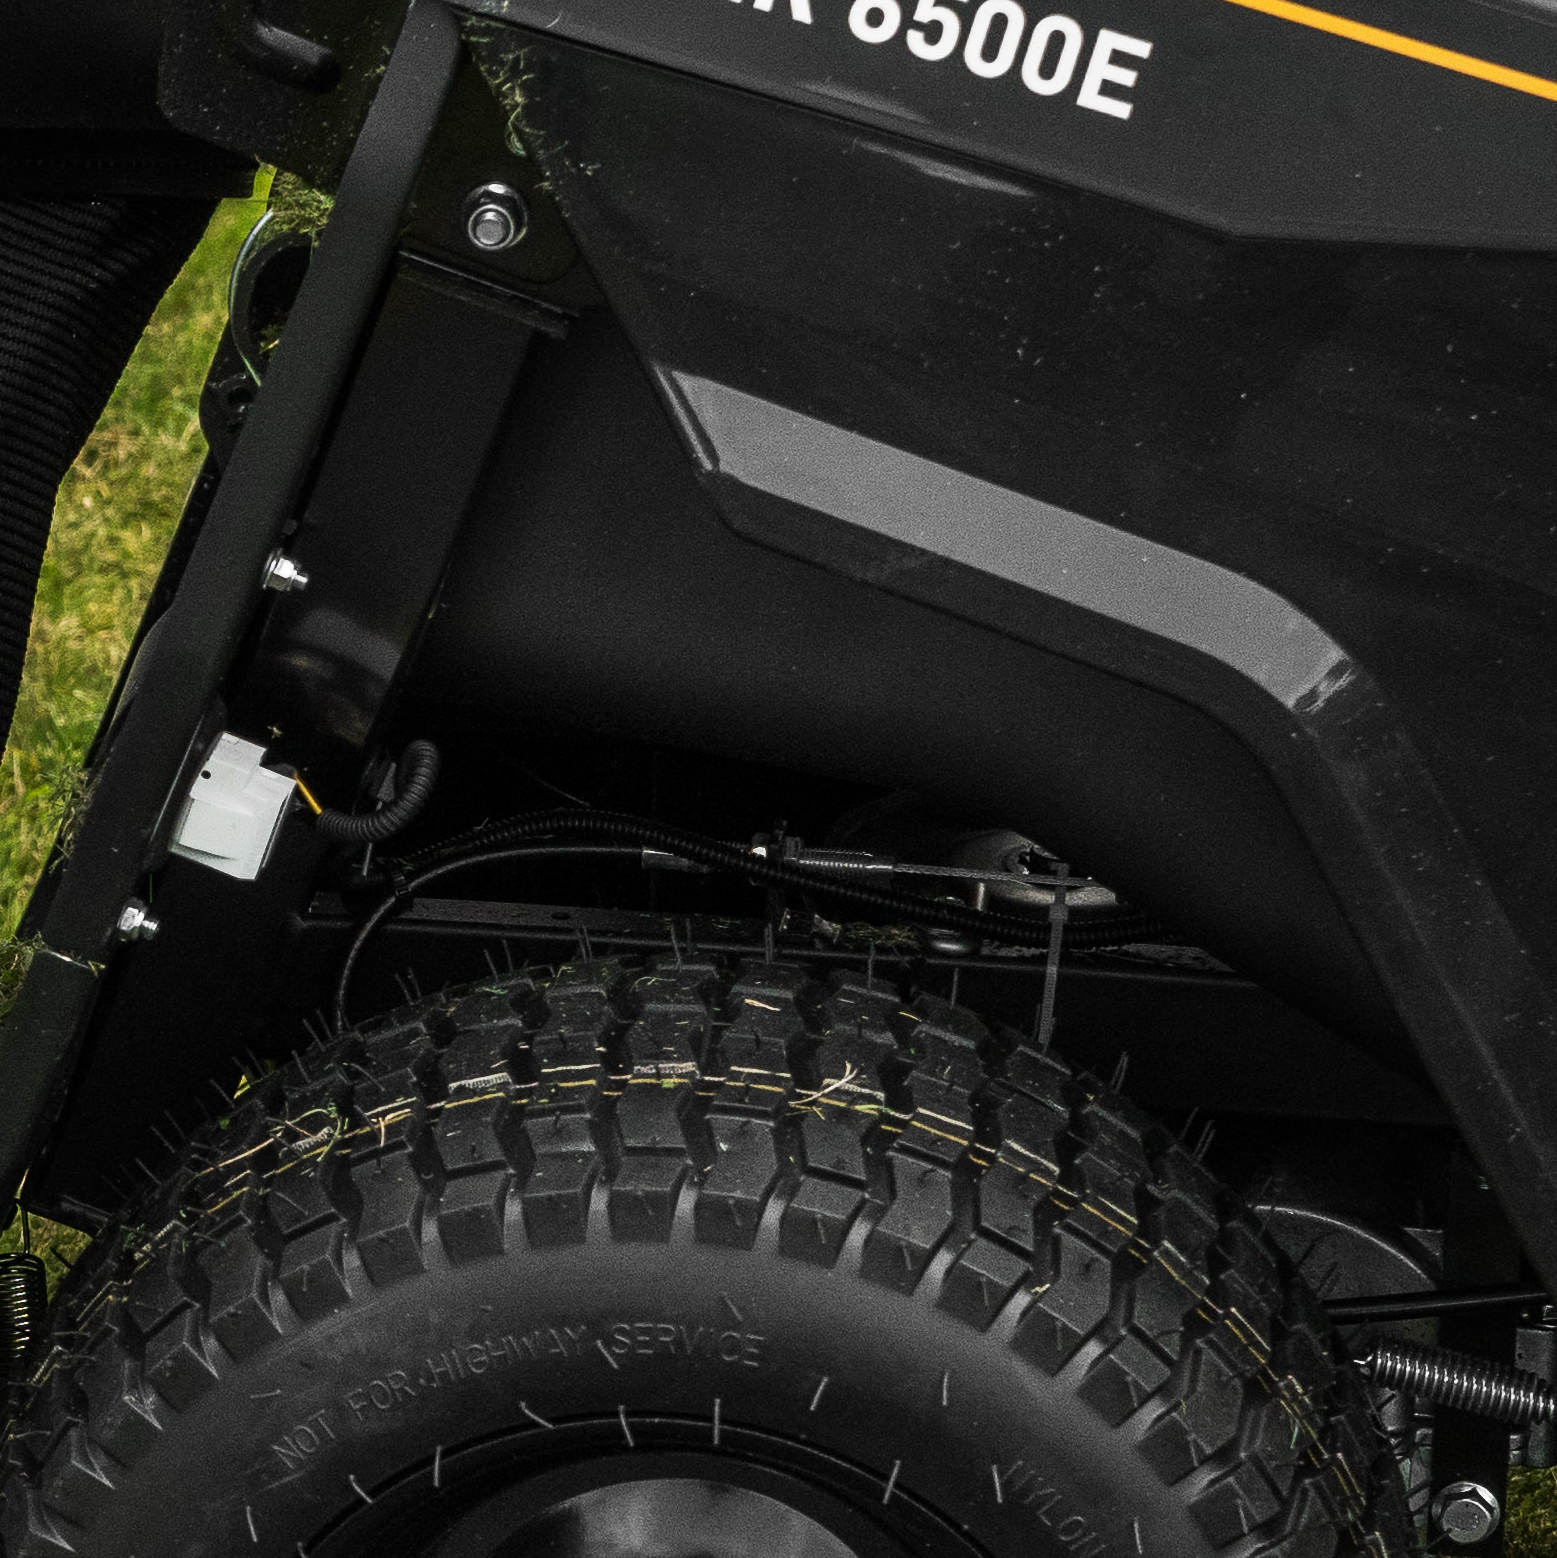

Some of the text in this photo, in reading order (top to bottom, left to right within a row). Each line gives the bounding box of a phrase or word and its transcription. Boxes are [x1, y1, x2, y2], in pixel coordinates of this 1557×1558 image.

[269, 1320, 768, 1470] NOT FOR HIGHWAY SERVICE
